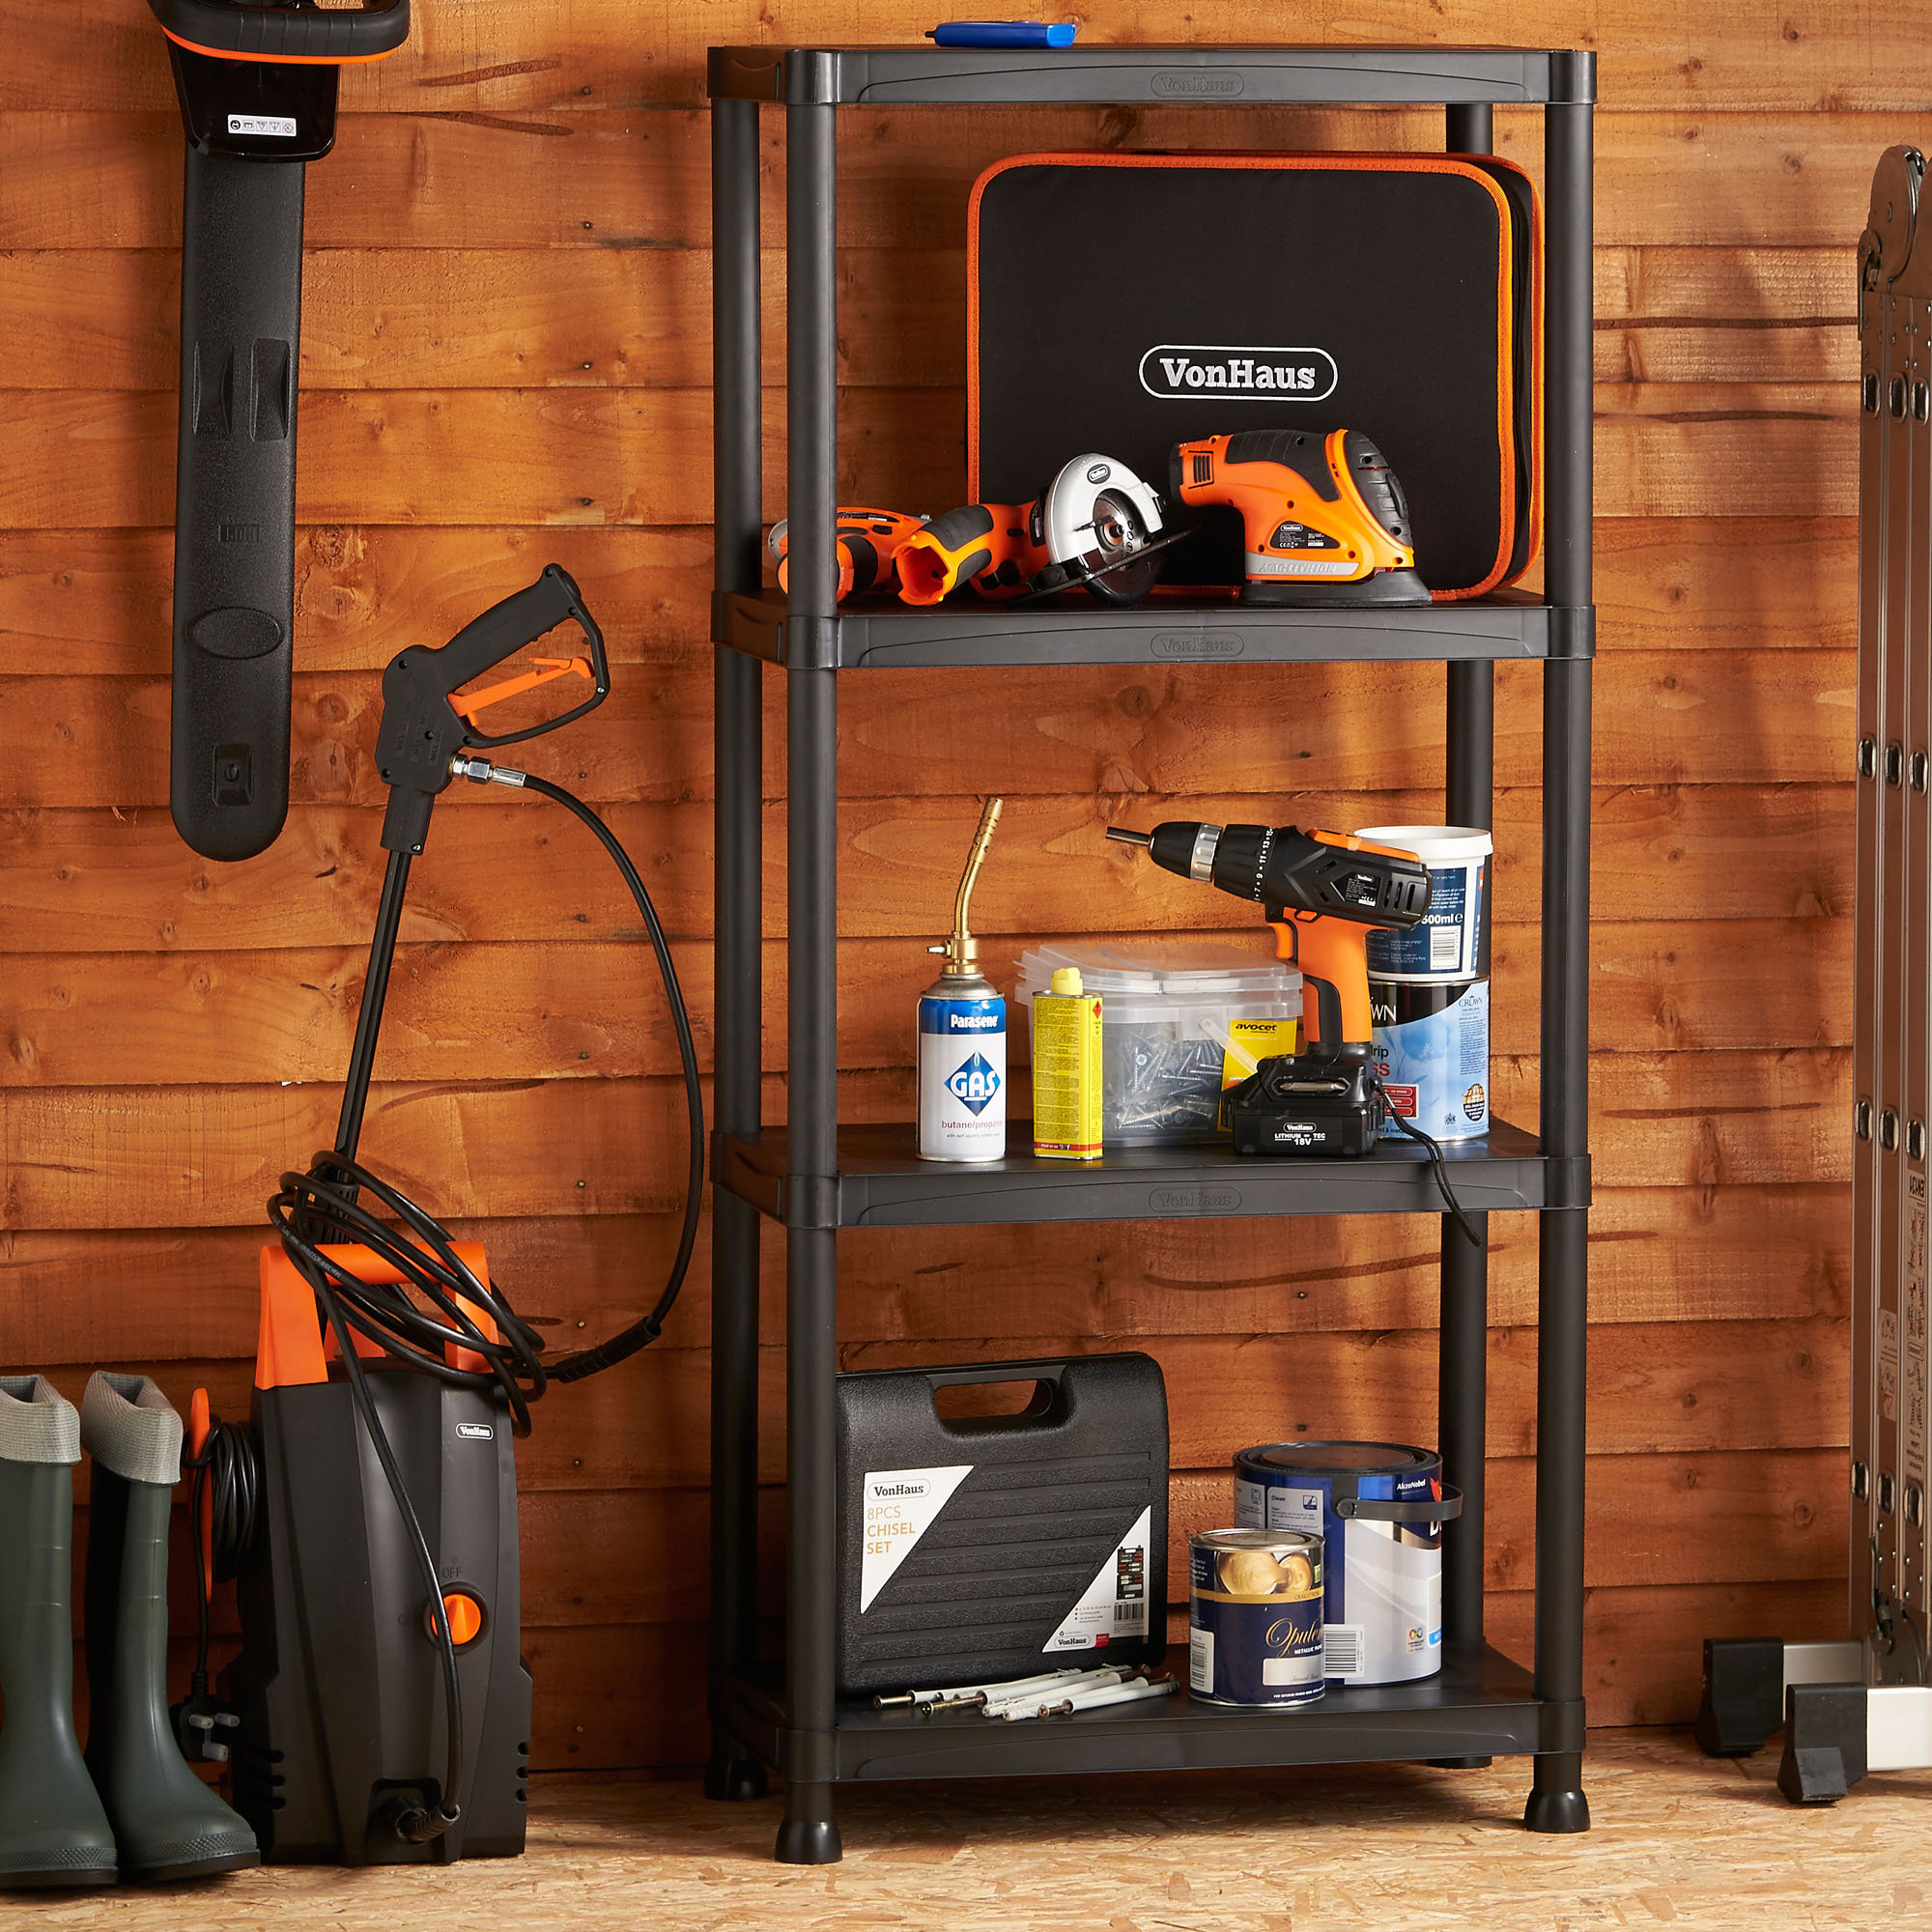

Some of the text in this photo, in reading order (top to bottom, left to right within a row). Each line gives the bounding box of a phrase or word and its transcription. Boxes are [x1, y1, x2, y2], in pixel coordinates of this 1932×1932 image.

[1160, 76, 1235, 93] VonHaus
[1159, 357, 1316, 390] VonHaus
[1160, 637, 1235, 654] VonHaus
[951, 1013, 999, 1028] Parasene
[1236, 1023, 1278, 1032] avocet
[950, 1070, 997, 1097] GAS
[941, 1120, 1004, 1130] butane/propane
[1158, 1190, 1232, 1208] VonHaus
[459, 1426, 491, 1437] VonHaus
[873, 1484, 924, 1497] VonHaus
[1396, 1478, 1426, 1491] AkzoNobel
[867, 1505, 901, 1521] 8PCS
[867, 1522, 916, 1538] CHISEL
[867, 1541, 892, 1555] SET
[441, 1567, 463, 1578] OFF
[1058, 1637, 1088, 1646] VonHaus
